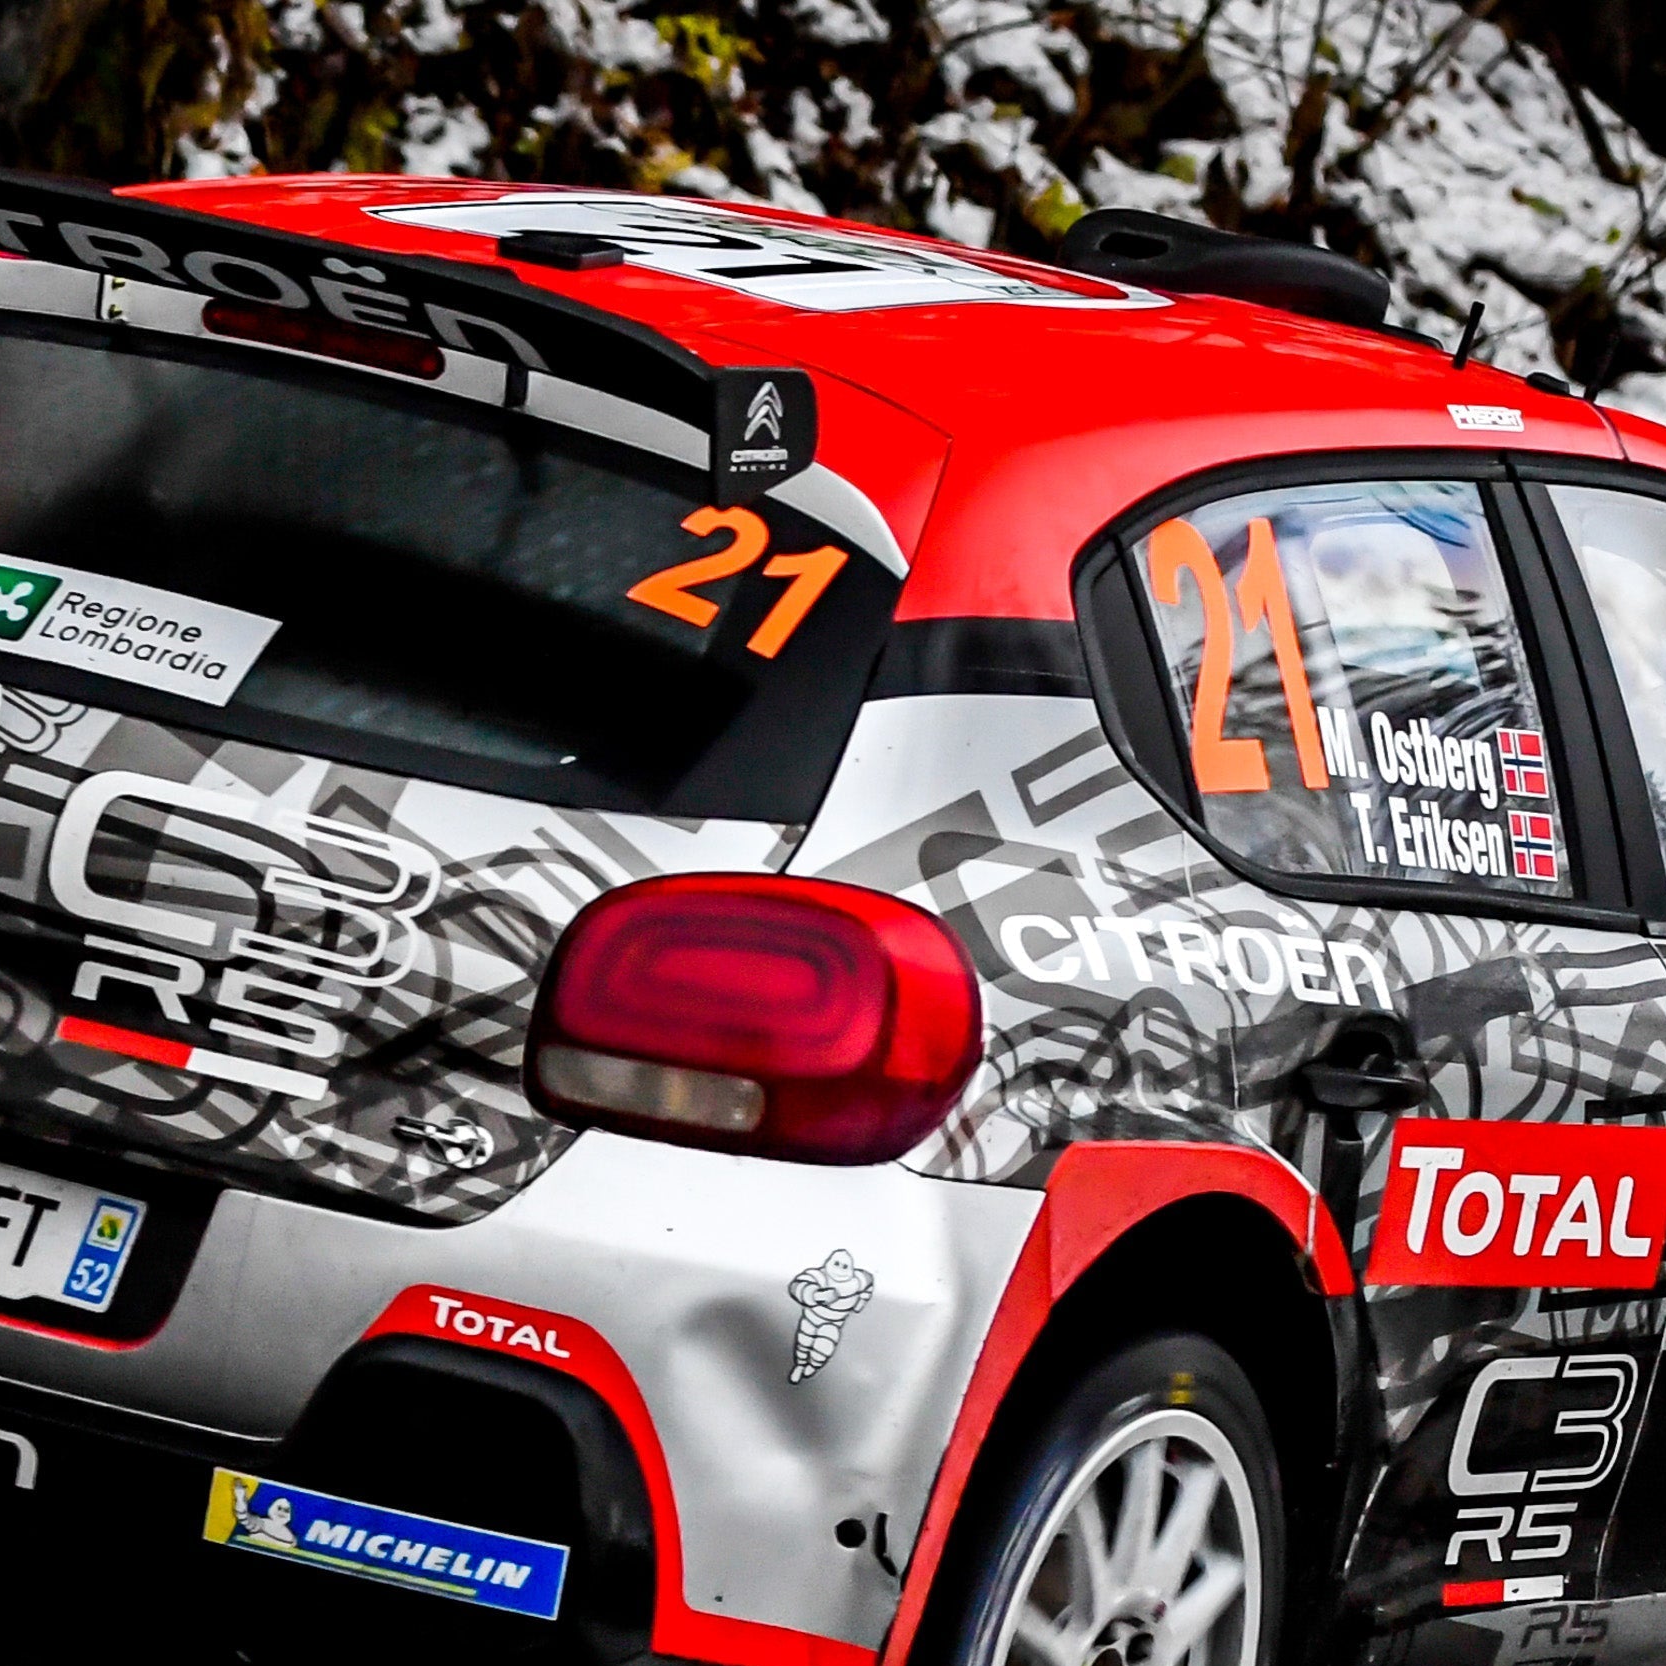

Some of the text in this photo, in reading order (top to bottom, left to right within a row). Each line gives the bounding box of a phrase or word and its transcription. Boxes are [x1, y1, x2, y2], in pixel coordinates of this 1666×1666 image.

[56, 591, 203, 643] Regione
[625, 505, 850, 660] 21
[39, 616, 228, 681] Lombardia
[1147, 517, 1329, 793] 21
[1316, 705, 1498, 810] M. Ostberg
[48, 770, 442, 988] C3
[1349, 792, 1508, 877] T. Eriksen
[999, 912, 1394, 1010] CITROËN
[1399, 1145, 1652, 1257] TOTAL
[71, 1258, 111, 1297] 52
[429, 1295, 571, 1359] TOTAL
[1447, 1353, 1639, 1497] C3
[305, 1519, 532, 1589] MICHELIN
[1444, 1502, 1579, 1566] R5
